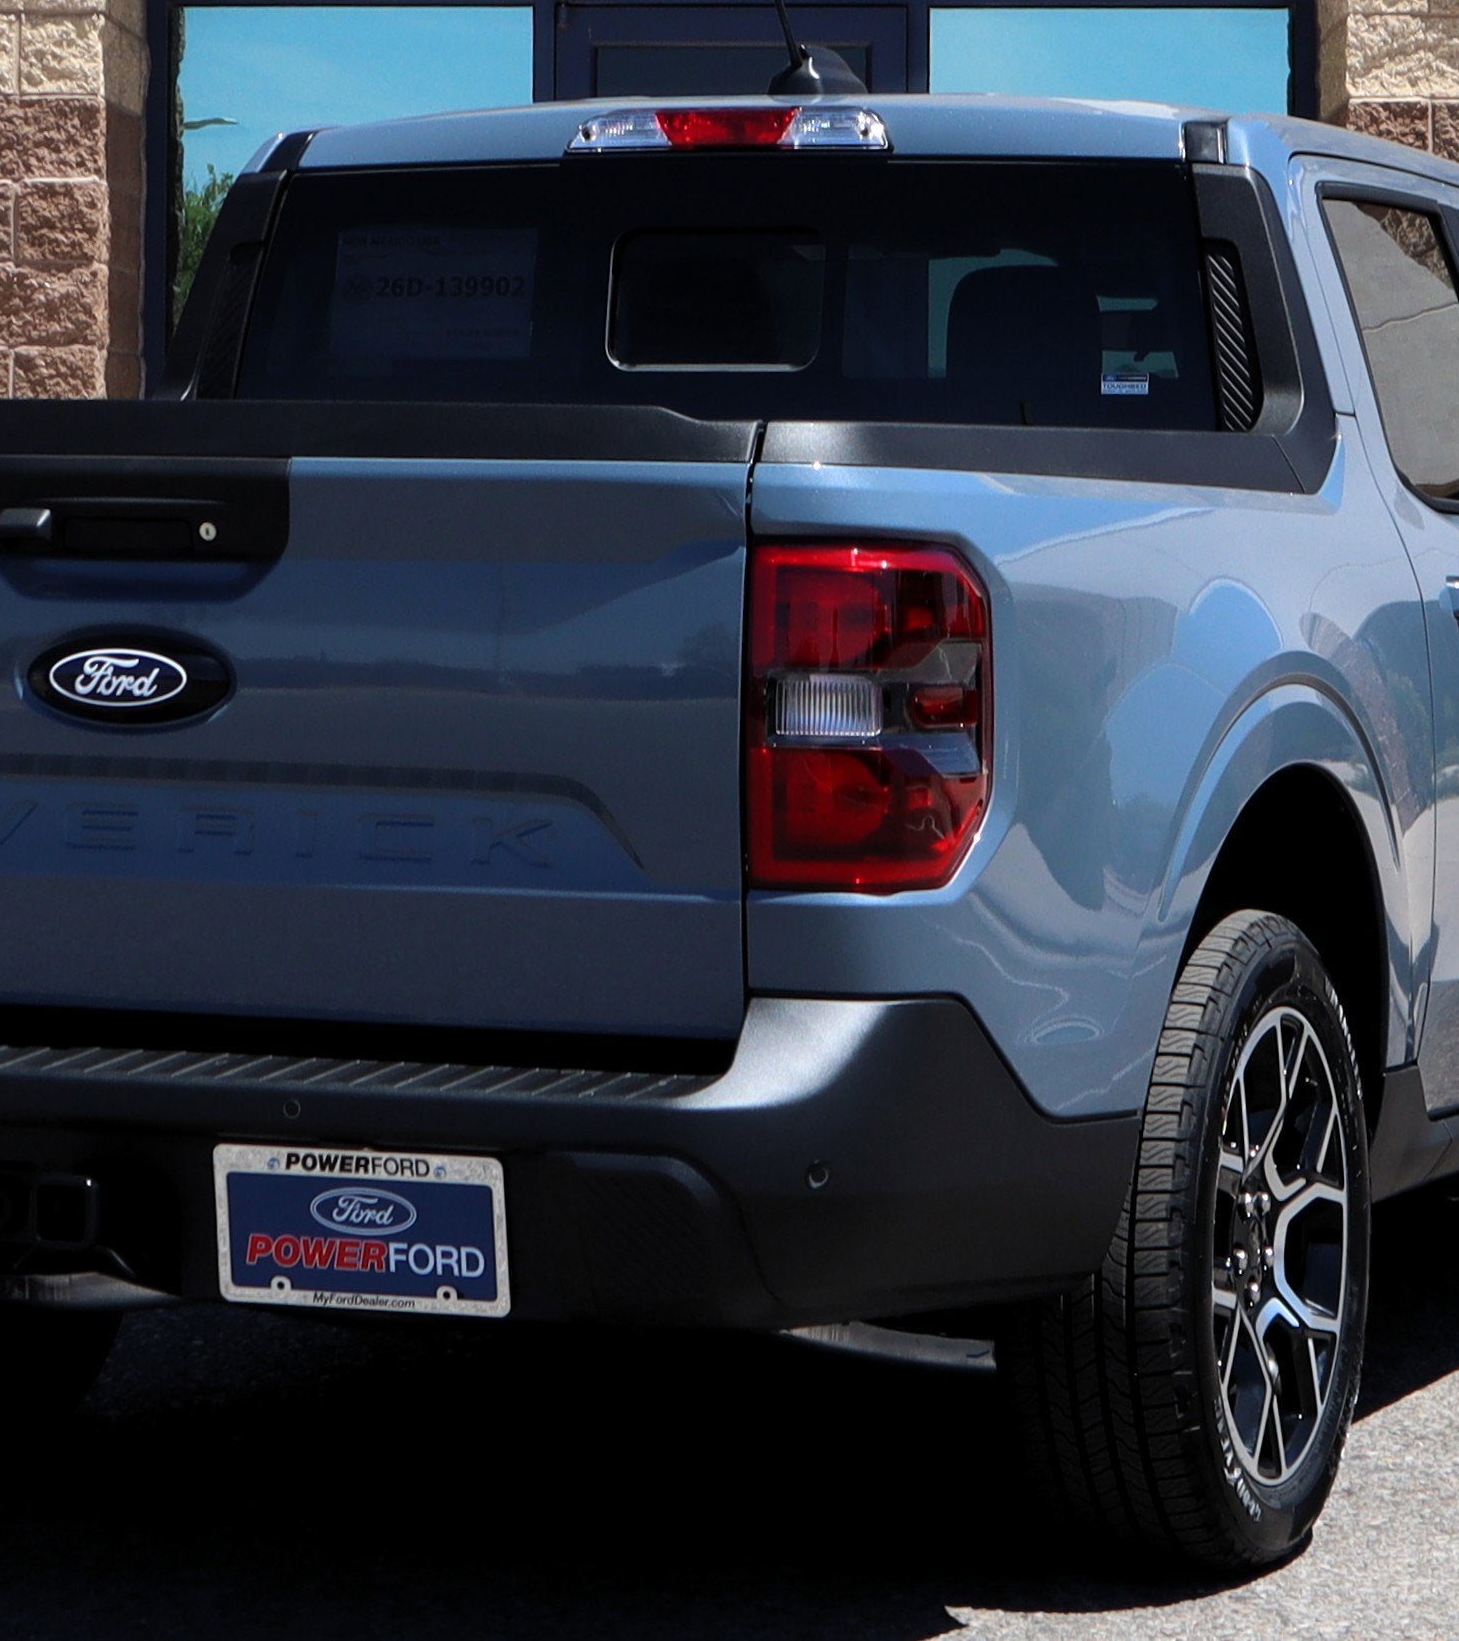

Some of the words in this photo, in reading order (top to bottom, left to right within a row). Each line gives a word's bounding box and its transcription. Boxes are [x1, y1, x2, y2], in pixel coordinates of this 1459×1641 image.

[375, 275, 527, 298] 26D-139902
[74, 655, 161, 698] Ford
[285, 1152, 430, 1178] POWERFORD
[331, 1194, 395, 1227] Ford
[246, 1233, 486, 1278] POWERFORD
[312, 1291, 416, 1310] MyFordDealer.com
